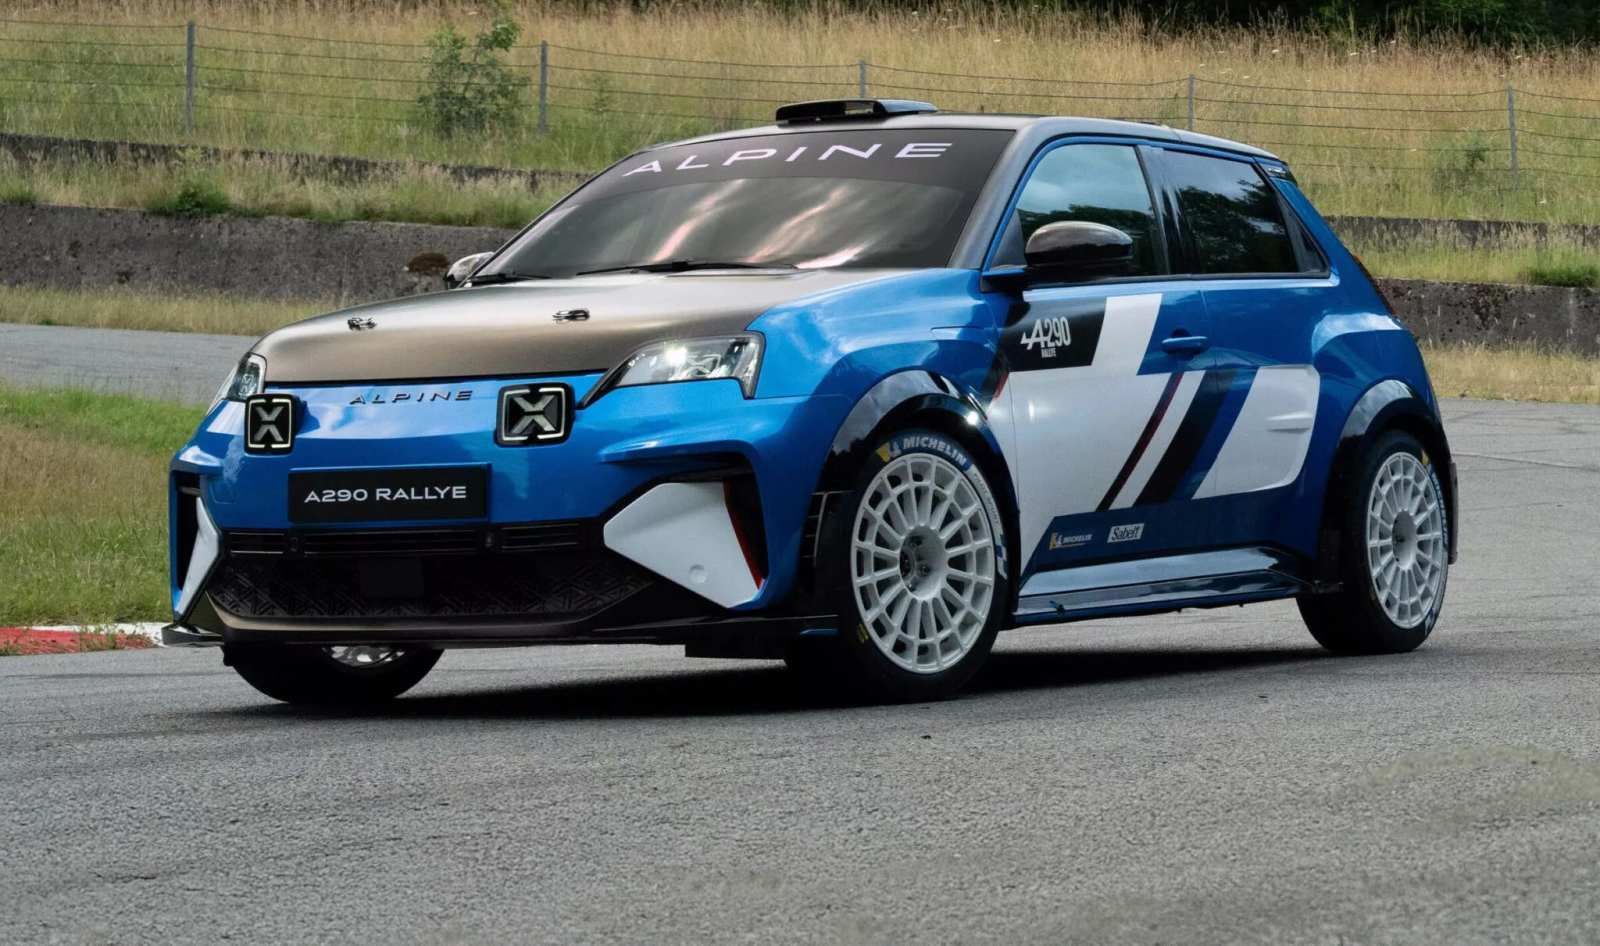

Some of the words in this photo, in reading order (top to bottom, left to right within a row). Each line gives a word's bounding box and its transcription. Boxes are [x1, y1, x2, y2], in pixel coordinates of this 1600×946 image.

[622, 143, 953, 176] ALPINE
[1041, 347, 1057, 358] RALLYE
[349, 390, 473, 405] ALPINE
[903, 436, 967, 466] MICHELIN
[304, 488, 368, 503] A290
[375, 486, 466, 501] RALLYE
[1063, 534, 1093, 544] MICHELIN
[1111, 526, 1140, 541] Sabelt
